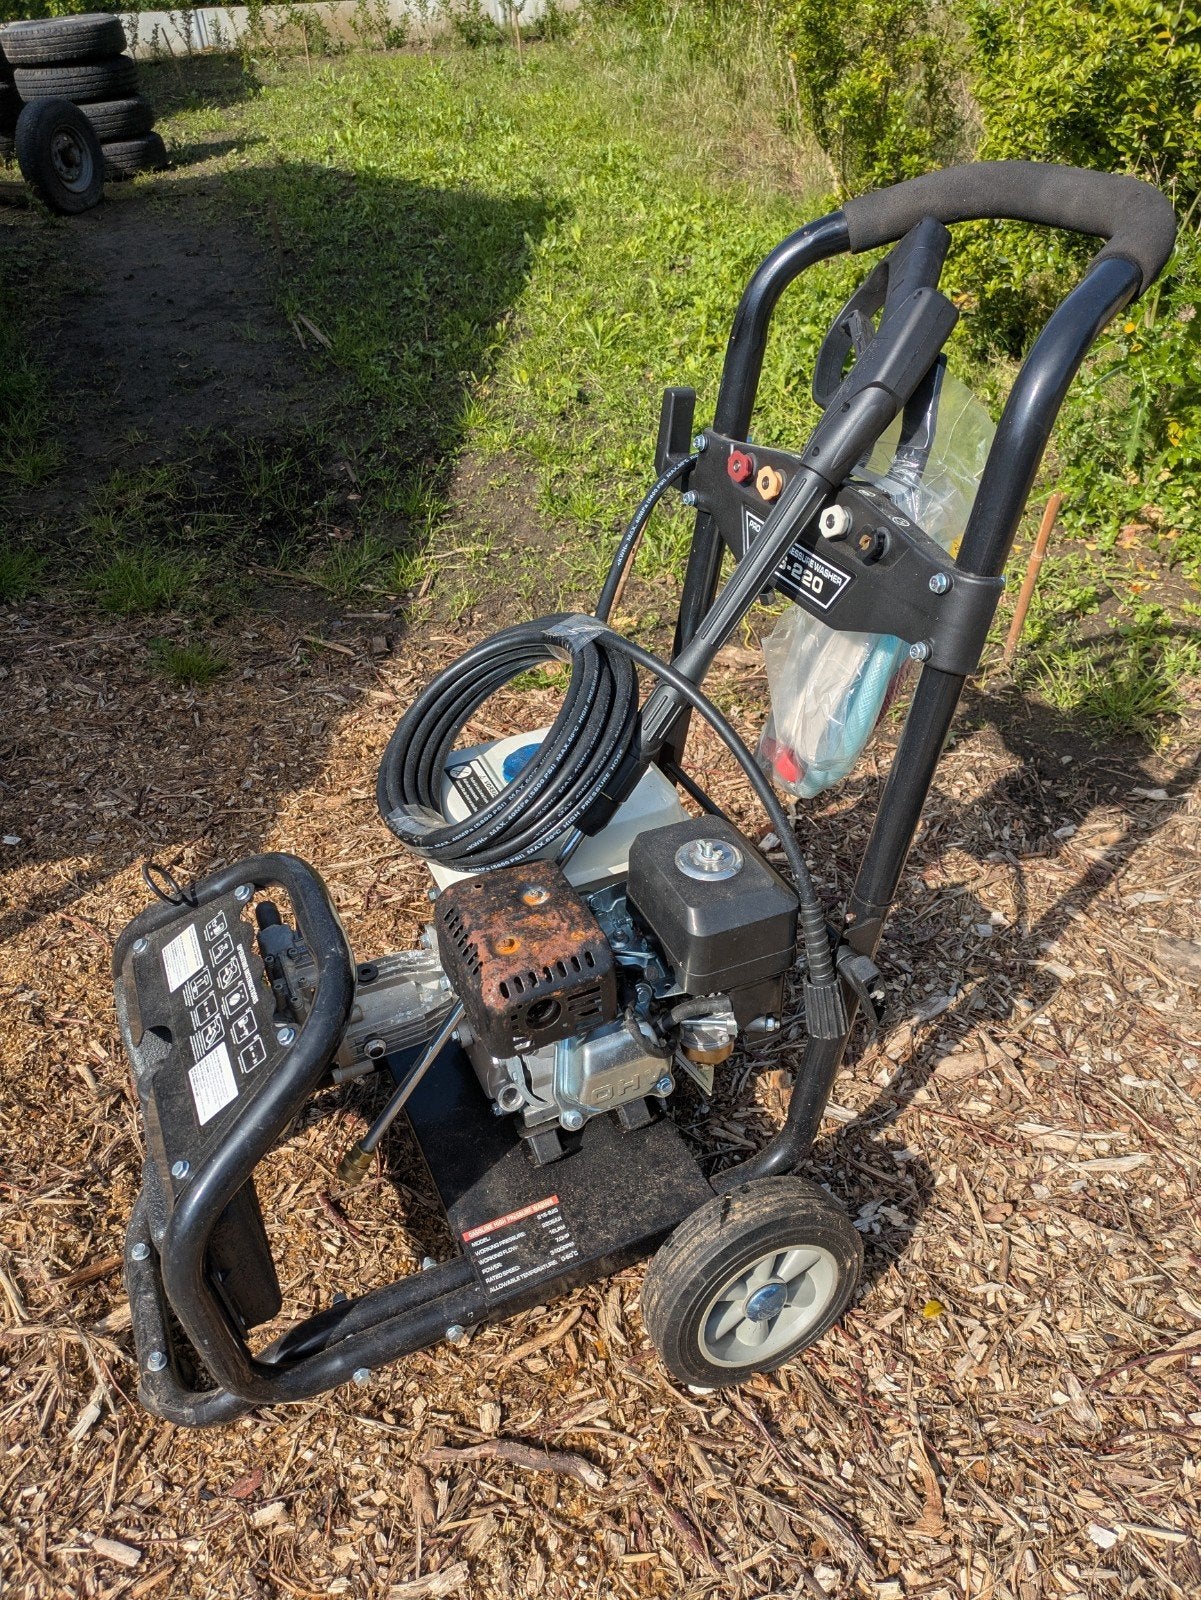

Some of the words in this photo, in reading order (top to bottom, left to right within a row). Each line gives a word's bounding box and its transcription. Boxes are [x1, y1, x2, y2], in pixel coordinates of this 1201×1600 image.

[813, 560, 843, 586] WASHER
[489, 822, 508, 836] MAX.
[528, 778, 544, 799] (5800
[544, 764, 557, 779] PSI)
[563, 811, 580, 828] HIGH
[580, 772, 610, 810] PRESSURE
[610, 749, 623, 770] HOSE
